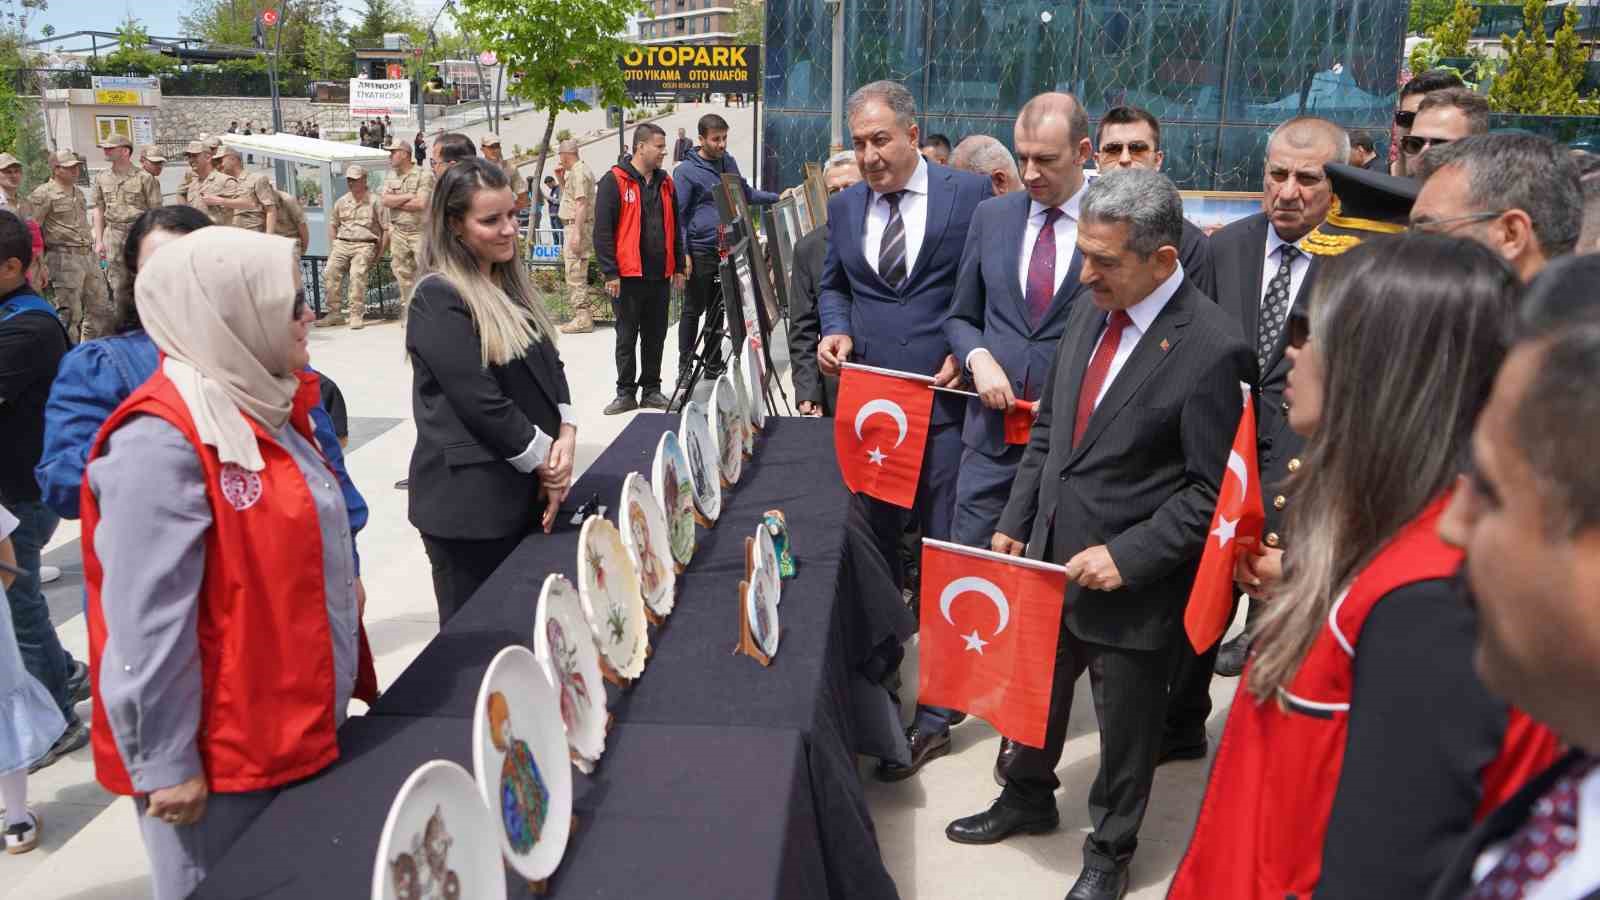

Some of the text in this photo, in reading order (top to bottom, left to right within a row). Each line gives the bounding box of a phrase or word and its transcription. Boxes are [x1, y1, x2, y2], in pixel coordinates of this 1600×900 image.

[624, 46, 748, 66] OTOPARK
[624, 70, 681, 81] OTO YIKAMA
[689, 68, 748, 81] OTO KUAFÖR
